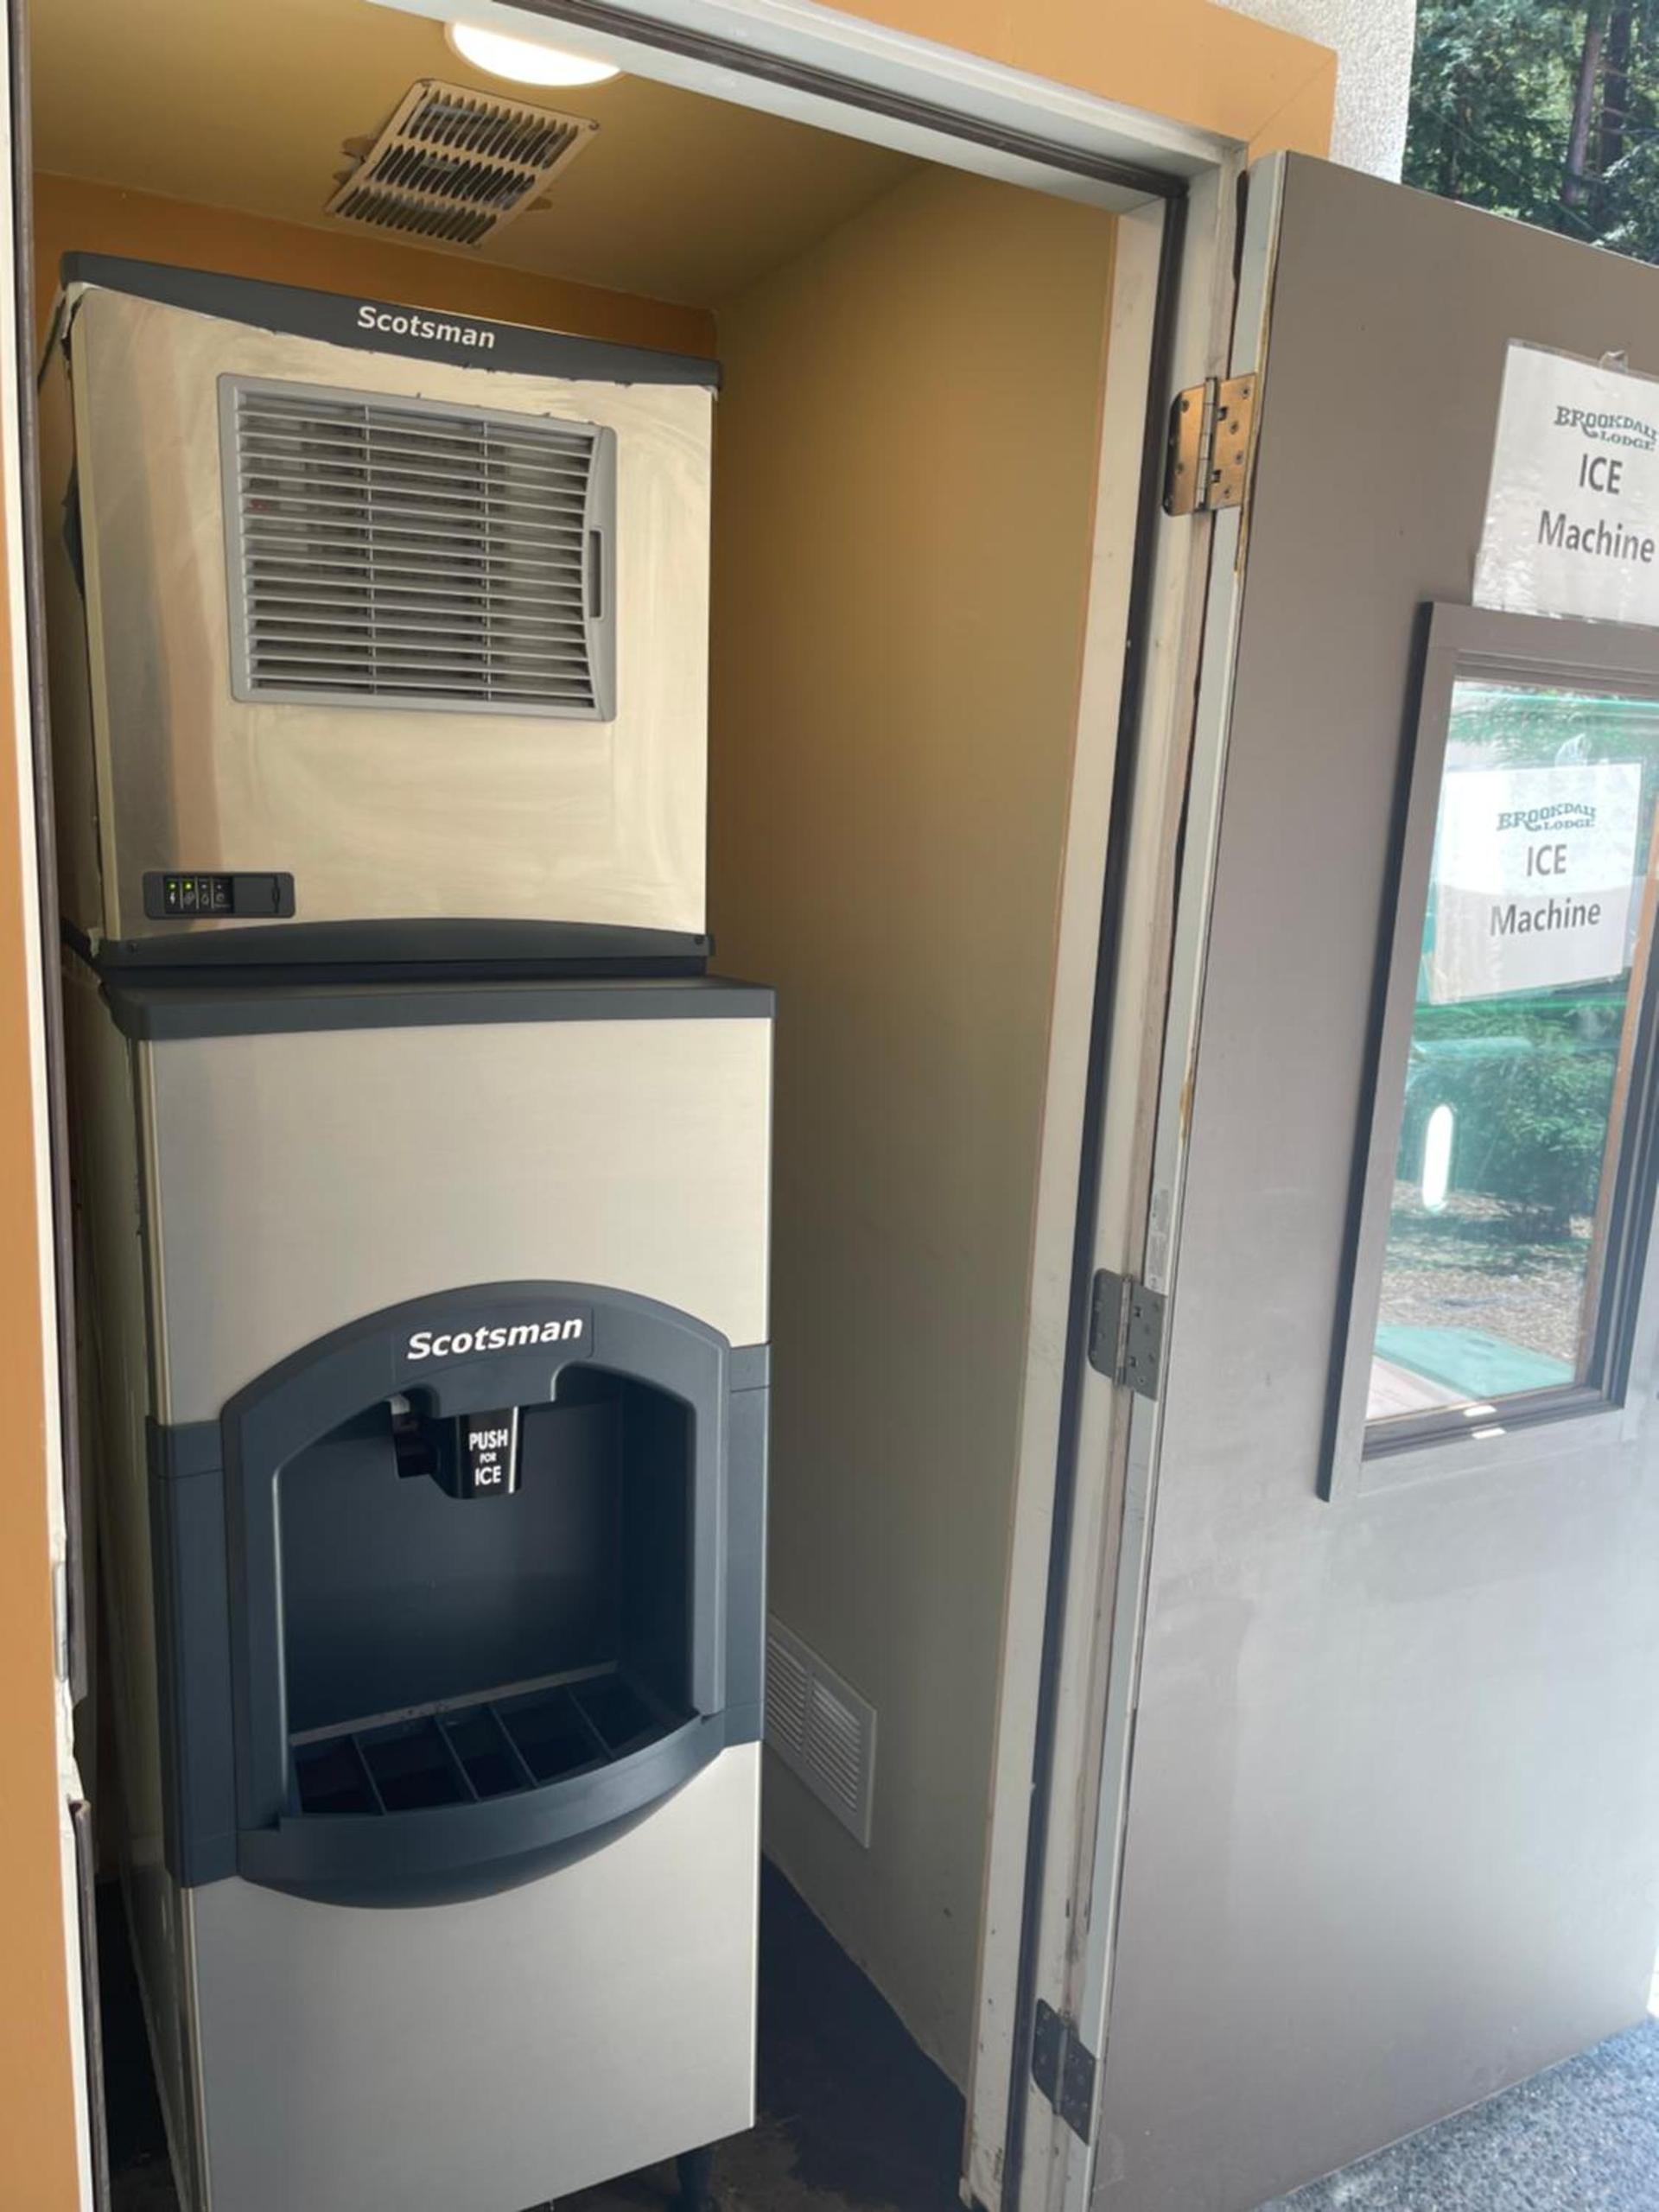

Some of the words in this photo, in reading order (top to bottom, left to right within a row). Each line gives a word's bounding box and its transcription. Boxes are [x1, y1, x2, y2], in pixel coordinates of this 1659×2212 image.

[357, 306, 495, 348] Scotsman
[1600, 431, 1655, 451] LODGE
[1580, 454, 1623, 495] ICE
[1538, 510, 1655, 563] Machine
[1543, 819, 1596, 830] LODGE
[1527, 844, 1567, 877] ICE
[1490, 898, 1601, 936] Machine
[407, 1319, 583, 1360] Scotsman
[469, 1429, 508, 1452] PUSH
[480, 1453, 496, 1464] FOR
[475, 1466, 501, 1485] ICE
